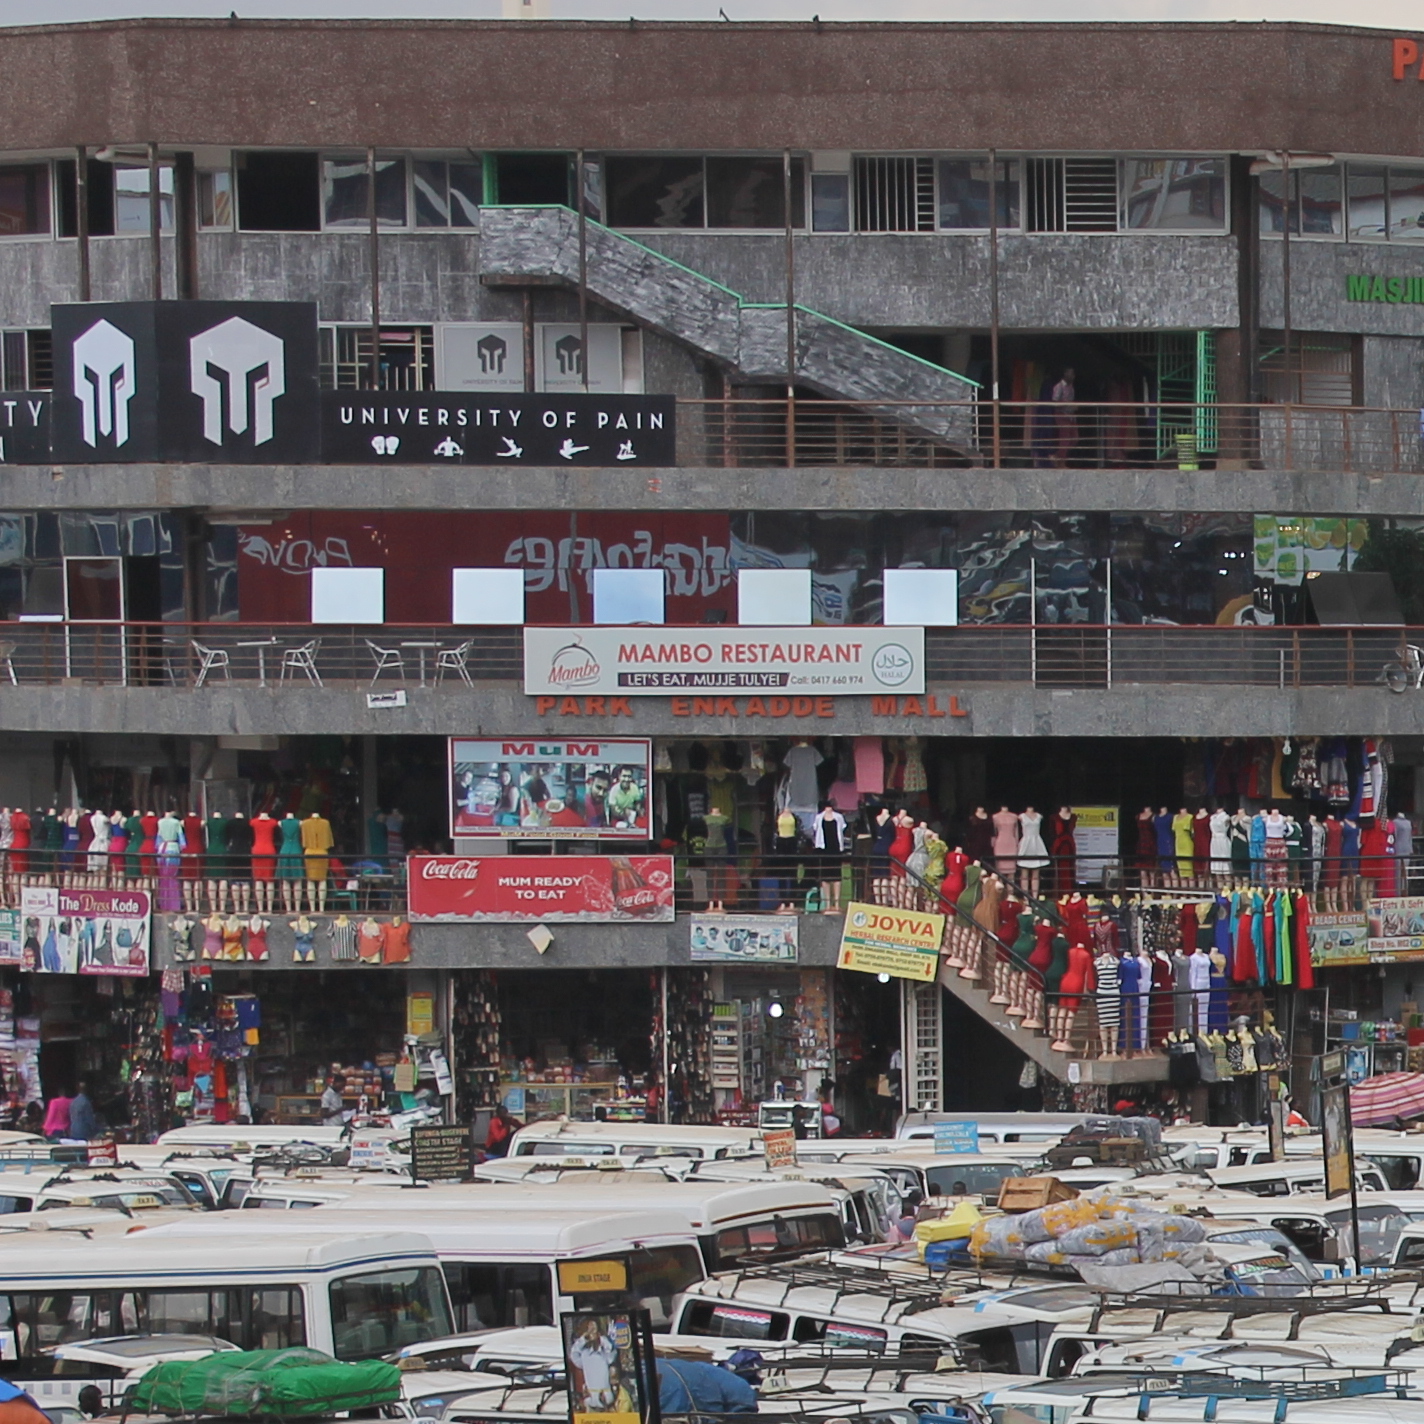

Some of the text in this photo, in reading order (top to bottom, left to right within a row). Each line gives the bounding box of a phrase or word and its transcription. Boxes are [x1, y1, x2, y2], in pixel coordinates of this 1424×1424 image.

[339, 406, 663, 430] UNIVERSITY OF PAIN
[617, 643, 863, 663] MAMBO RESTAURANT
[548, 657, 601, 684] Mambo
[627, 673, 658, 686] LET'S
[663, 673, 690, 688] EAT,
[694, 673, 736, 686] MUJJE
[536, 696, 968, 718] PARK ENKADDE MALL
[422, 859, 480, 881] Coca-Cola
[499, 877, 583, 887] MUM READY
[59, 894, 139, 913] The Dress Kode
[515, 889, 567, 900] TO EAT
[868, 913, 935, 938] JOYVA
[1315, 914, 1366, 925] BEADS CENTRE
